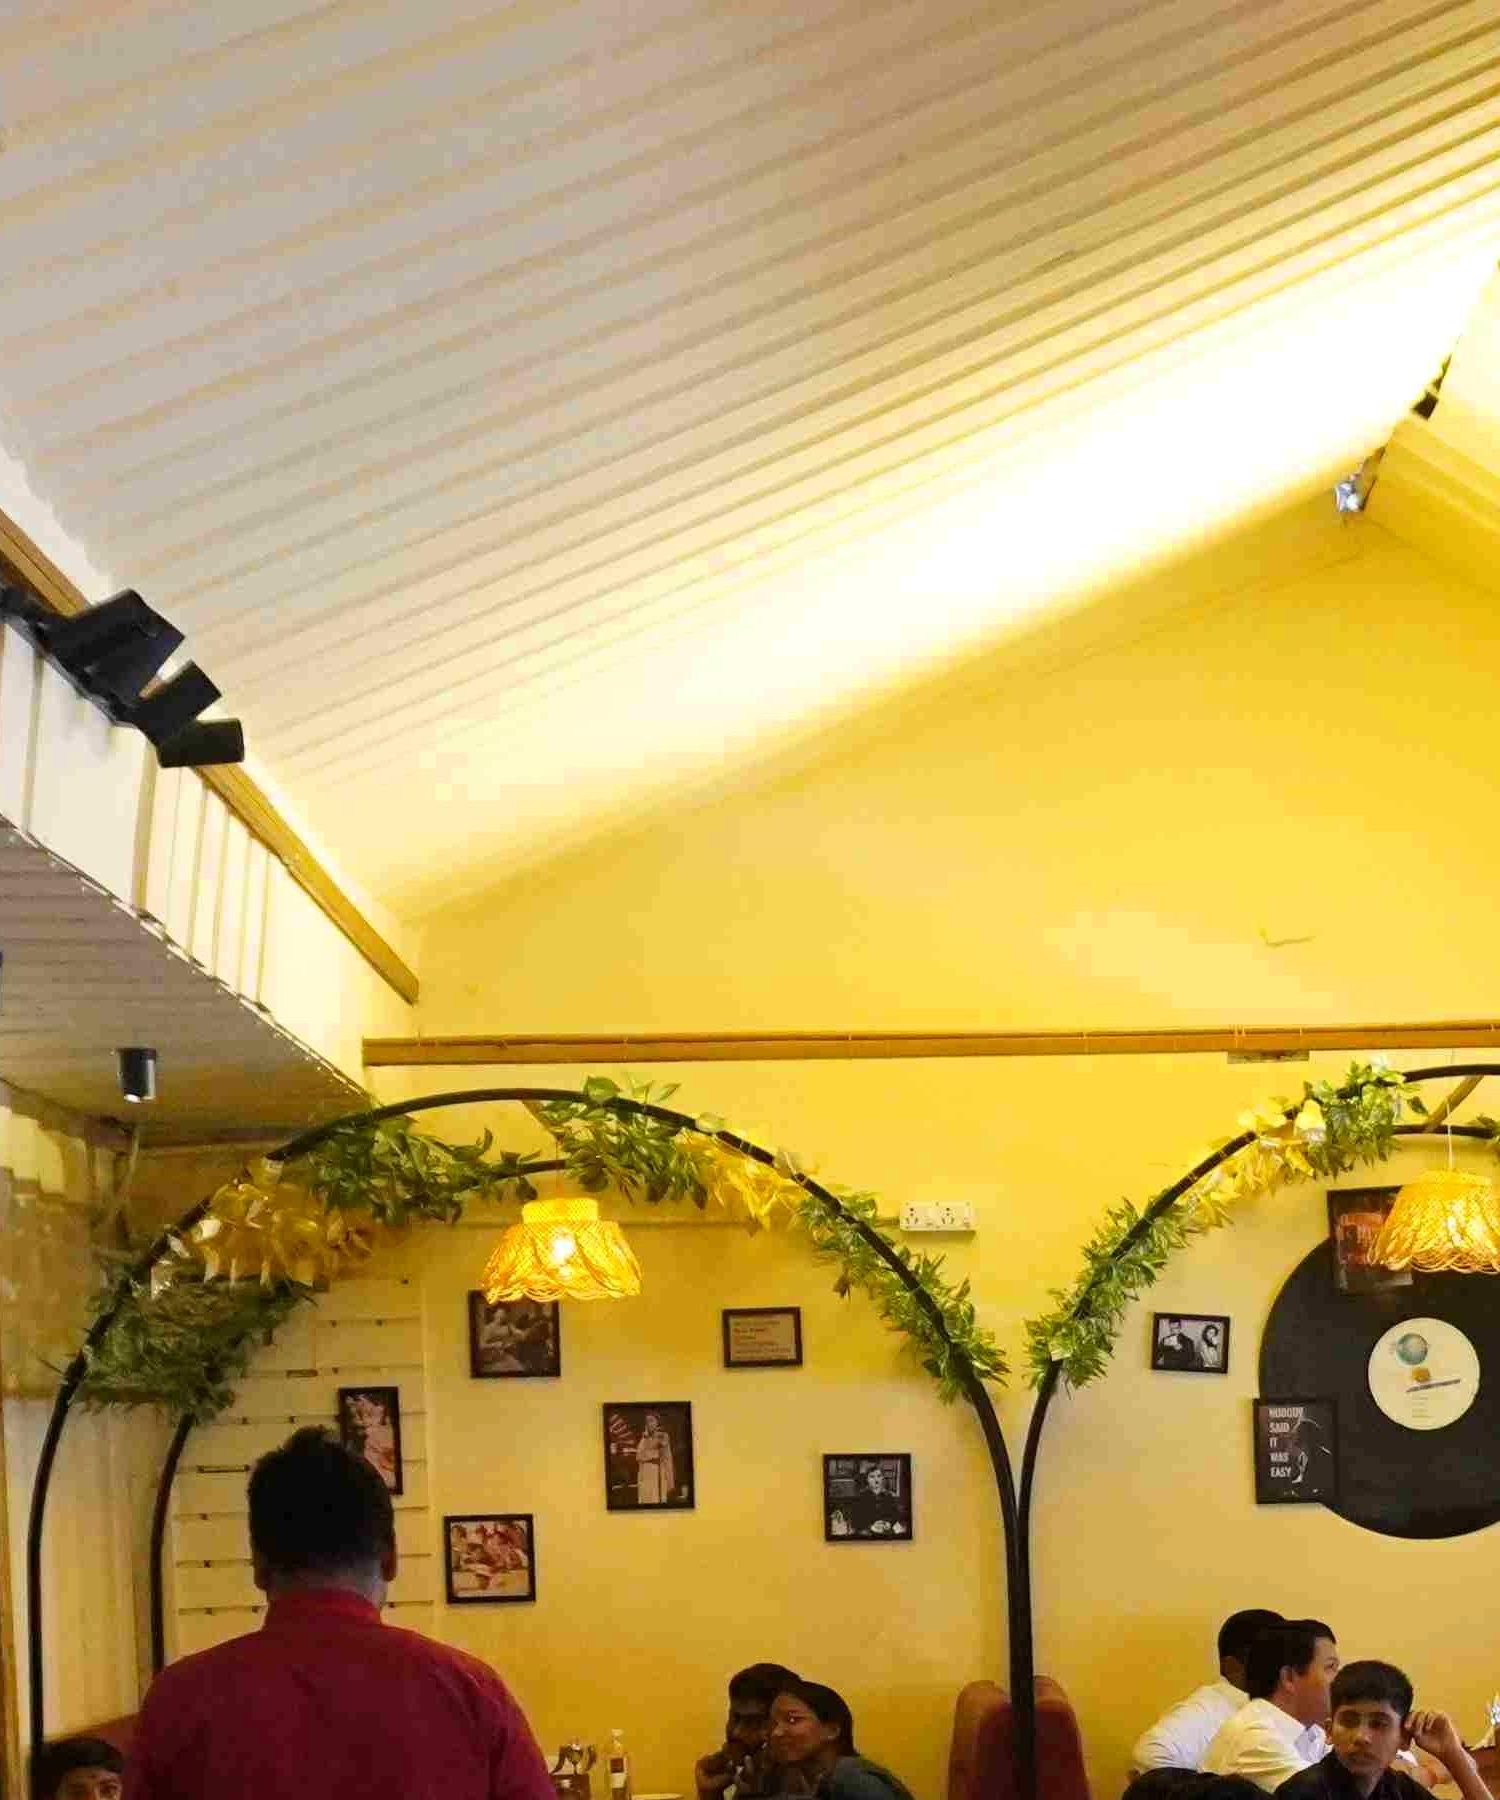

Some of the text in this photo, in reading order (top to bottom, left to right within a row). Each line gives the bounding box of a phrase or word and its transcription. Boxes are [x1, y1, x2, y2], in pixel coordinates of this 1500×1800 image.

[1269, 1422, 1289, 1433] SAID
[1269, 1437, 1277, 1448] IT
[1270, 1466, 1292, 1478] EASY
